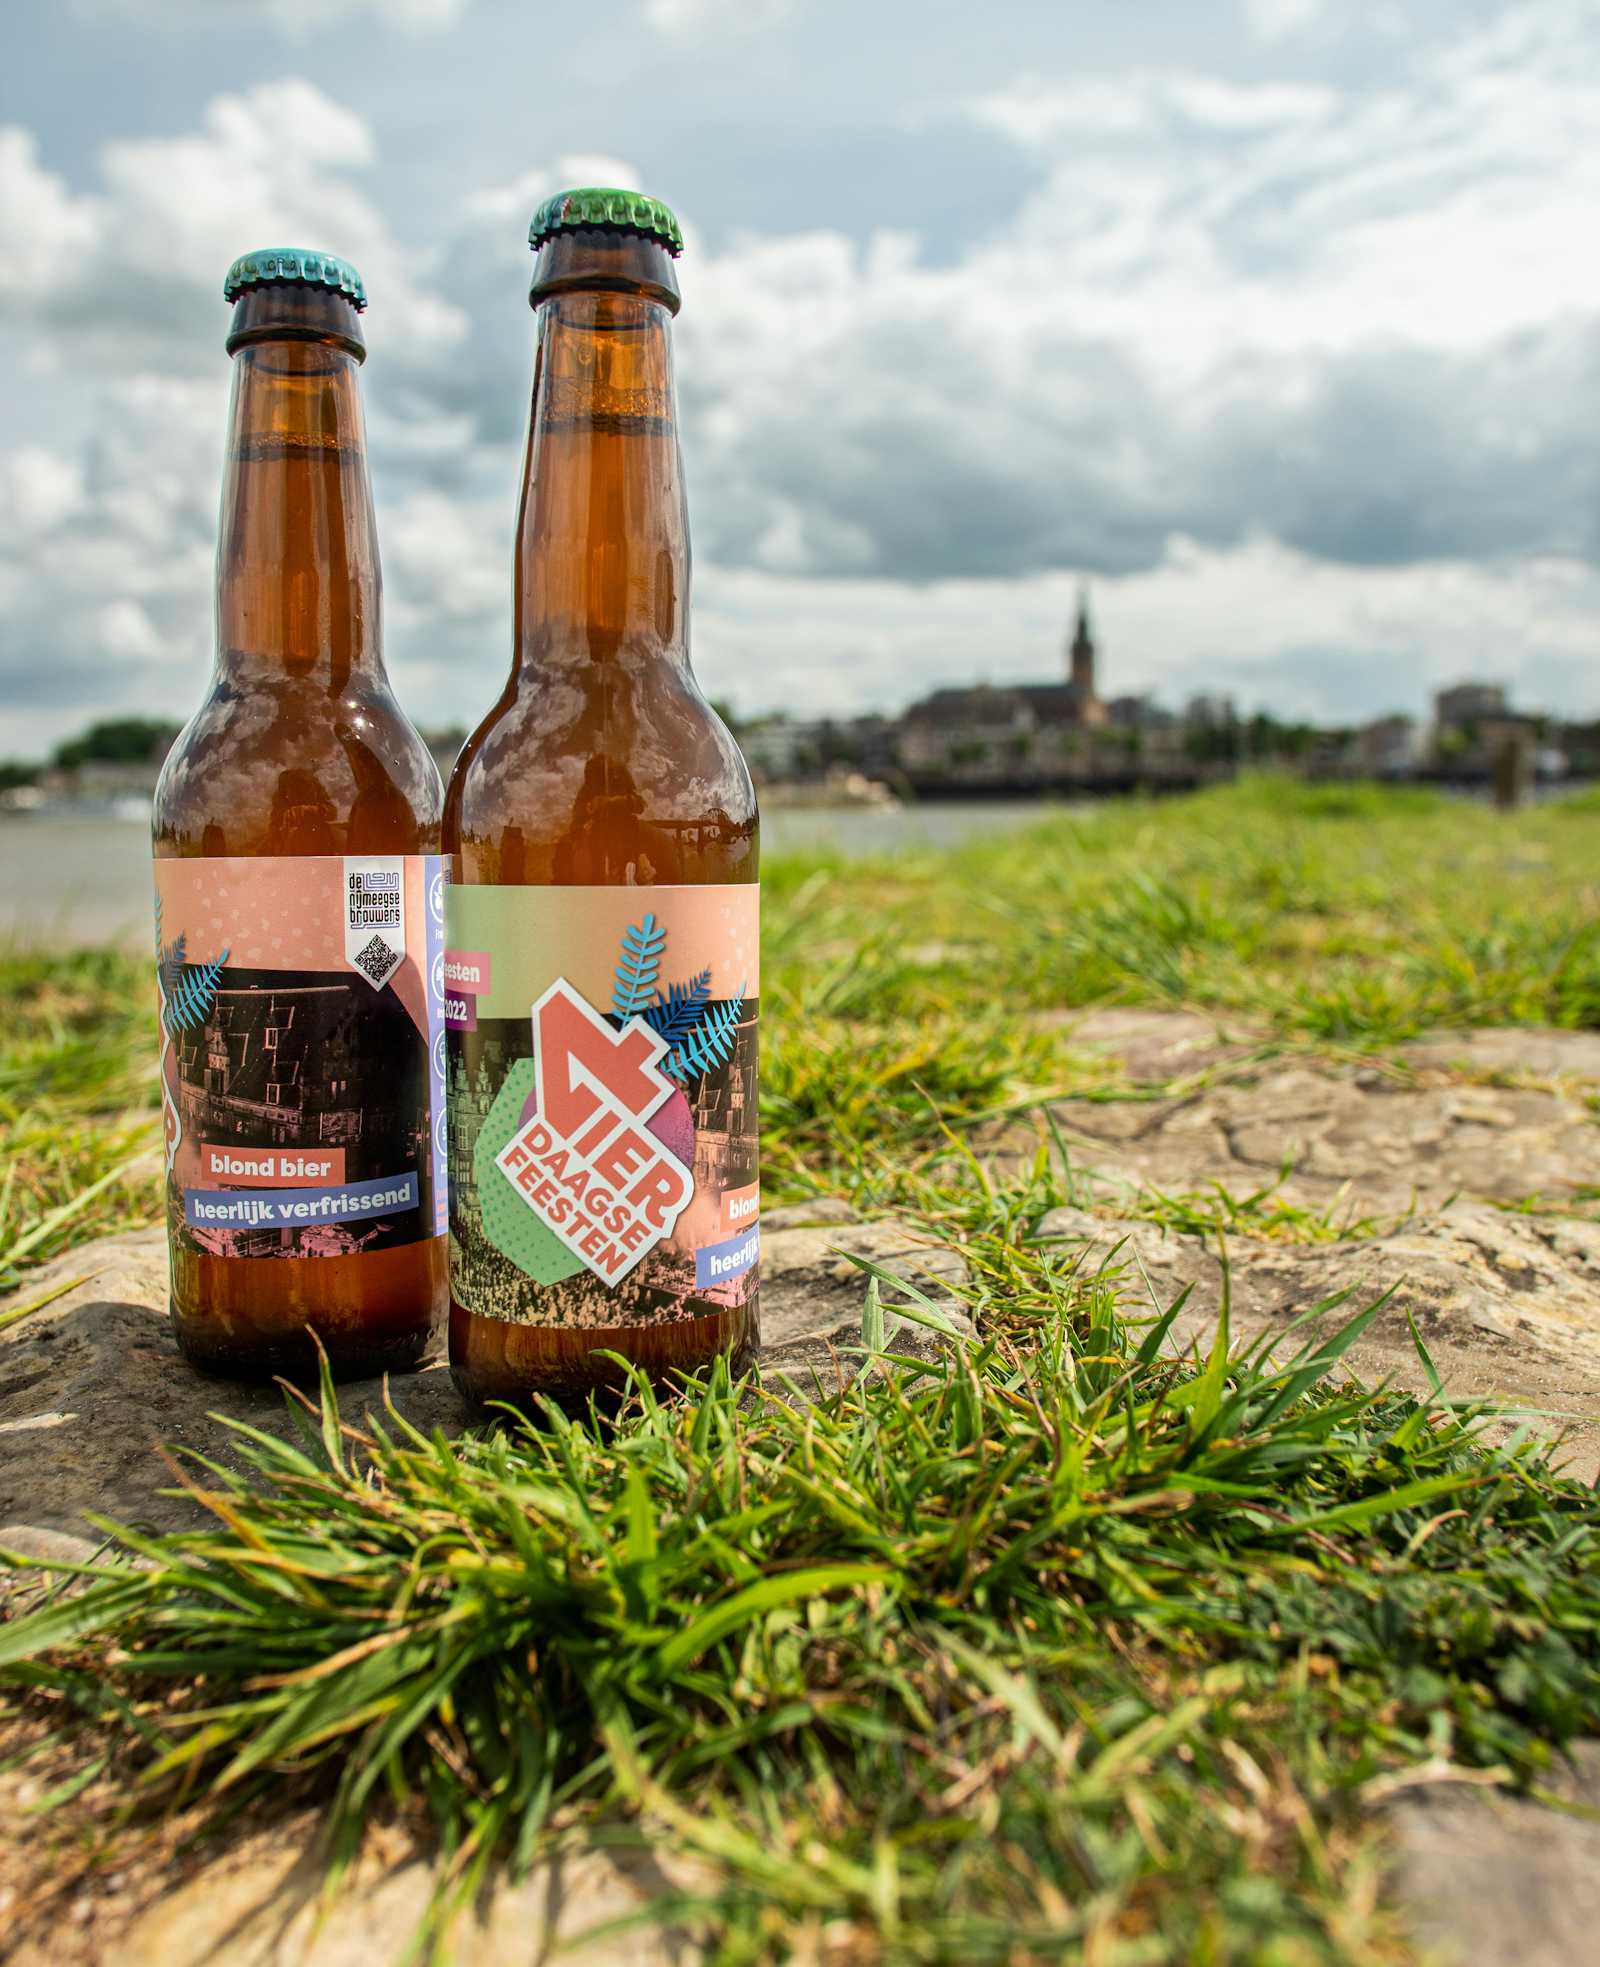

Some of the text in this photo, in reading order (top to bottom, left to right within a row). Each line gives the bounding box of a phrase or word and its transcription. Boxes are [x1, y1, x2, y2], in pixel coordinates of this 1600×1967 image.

[349, 872, 362, 889] de
[350, 908, 400, 923] brouwers
[210, 1153, 332, 1177] blond bier
[194, 1199, 275, 1225] heerlijk
[278, 1183, 411, 1219] verfrissend
[522, 1123, 651, 1252] DAAGSE
[503, 1145, 628, 1276] FEESTEN
